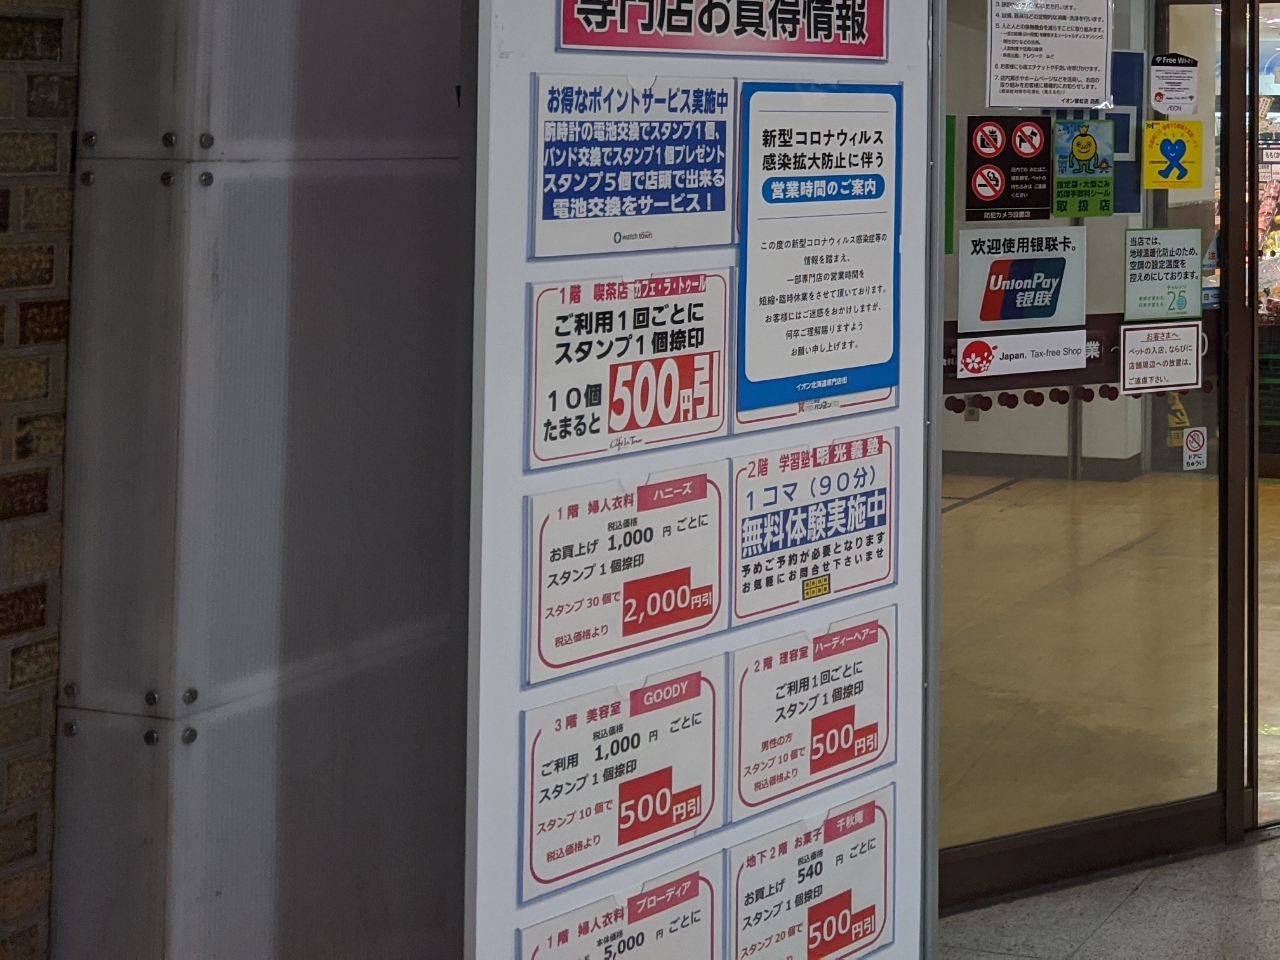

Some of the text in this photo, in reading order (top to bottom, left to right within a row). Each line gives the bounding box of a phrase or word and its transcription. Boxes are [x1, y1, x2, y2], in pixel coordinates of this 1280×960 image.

[548, 85, 729, 115] お得なポイントサービス実施中
[762, 128, 884, 147] 新型コロナウィルス
[543, 142, 726, 167] バンド交換でスタンプ1個プレゼント
[762, 151, 884, 171] 感染拡大防止に伴う
[543, 167, 725, 193] スタンプ5個で店頭で出来る
[771, 179, 876, 199] 営業時間のご案内
[553, 190, 714, 219] 電池交換をサービス！
[971, 236, 1077, 255] 欢迎使用银联卡。
[1130, 237, 1161, 246] 当店では、
[1130, 247, 1198, 258] 地球温暖化防止のため、
[804, 254, 851, 265] 情報を踏まえ、
[1130, 260, 1186, 270] 空調の設定温度を
[787, 269, 865, 284] 一部専門店の営業時間を
[989, 272, 1059, 291] UnionPay
[1130, 271, 1198, 282] 控えめにしております。
[559, 285, 581, 304] 1階
[594, 281, 628, 302] 喫茶店
[1015, 291, 1052, 308] 银联
[555, 302, 704, 337] ご利用1回ごとに
[765, 302, 881, 323] お客様にはご迷惑をおかけしますが、
[786, 322, 864, 340] 何卒ご理解賜りますよう
[555, 327, 704, 365] スタンプ1個捺印
[791, 340, 859, 356] お願い申し上げます。
[999, 347, 1082, 361] Japan. Tax-free Shop
[1129, 344, 1193, 355] ペットの入店、ならびに
[1129, 375, 1169, 384] ご遠慮下さい。
[548, 383, 602, 412] 10個
[609, 351, 718, 432] 500円引
[544, 412, 600, 442] たまると
[748, 458, 768, 478] 2階
[779, 450, 810, 472] 学習塾
[557, 482, 692, 520] 1階 婦人衣料 ハニーズ
[607, 518, 638, 531] 税込価格
[742, 490, 886, 556] 無料体験実施中
[550, 514, 708, 562] お買上げ 1,000 円 ごとに
[742, 531, 886, 578] 予めご予約が必要となります
[742, 549, 884, 594] お気軽にお問合せ下さいませ
[555, 625, 608, 648] 税込価格より
[754, 628, 877, 673] 2階 理容室 ハーディーヘアー
[776, 661, 863, 700] ご利用1回ごとに
[555, 681, 688, 732] 3階 美容室 GOODY
[592, 724, 624, 741] 税込価格
[761, 733, 793, 752] 男性の方
[541, 712, 702, 777] ご利用 1,000 円 ごとに
[754, 769, 798, 792] 税込価格より
[546, 835, 601, 863] 税込価格より
[746, 828, 822, 868] 地下2階 お菓子
[744, 838, 876, 906] お買上げ 540 ごとに
[547, 882, 692, 948] 1階 婦人衣料 ブローディア
[669, 910, 701, 933] ごとに
